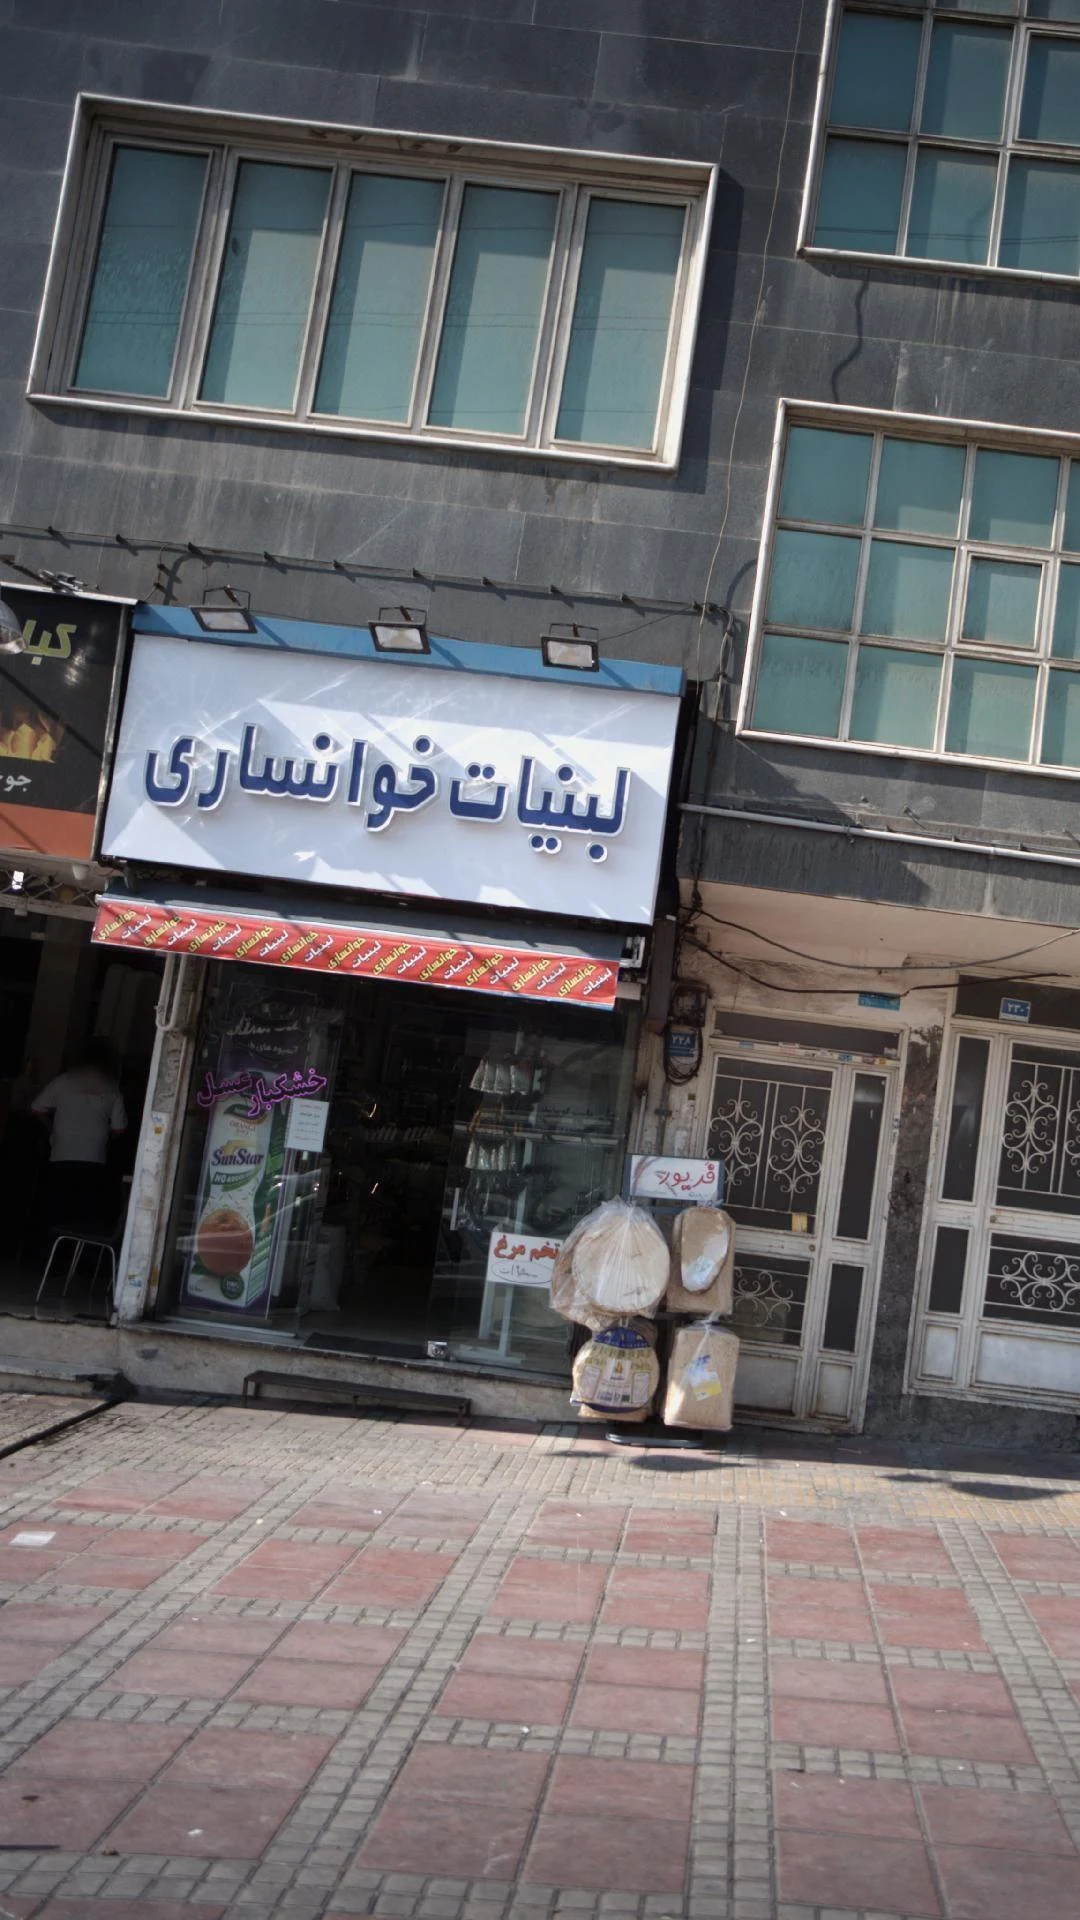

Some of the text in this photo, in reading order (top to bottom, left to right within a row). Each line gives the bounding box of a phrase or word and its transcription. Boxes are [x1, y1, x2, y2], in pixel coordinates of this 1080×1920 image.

[22, 619, 77, 665] کبا
[0, 774, 32, 792] جو
[145, 722, 632, 863] لبنیات خوانساری
[97, 909, 137, 941] خوانساری
[121, 914, 152, 940] لبنیات
[143, 915, 183, 947] خوانساری
[167, 919, 198, 946] لبنیات
[188, 919, 227, 953] خوانساری
[212, 924, 242, 951] لبنیات
[234, 925, 273, 958] خوانساری
[258, 930, 289, 957] لبنیات
[281, 931, 319, 964] خوانساری
[304, 935, 334, 962] لبنیات
[328, 937, 367, 969] خوانساری
[352, 940, 382, 968] لبنیات
[373, 943, 412, 976] خوانساری
[398, 946, 428, 974] لبنیات
[419, 948, 458, 981] خوانساری
[444, 952, 474, 979] لبنیات
[465, 952, 504, 986] خوانساری
[489, 957, 519, 985] لبنیات
[512, 958, 551, 992] خوانساری
[536, 962, 567, 991] لبنیات
[558, 963, 597, 997] خوانساری
[583, 968, 613, 996] لبنیات
[197, 1068, 327, 1117] خشکبار عسل
[211, 1147, 264, 1167] SunStar
[494, 1235, 560, 1262] تخم مرغ
